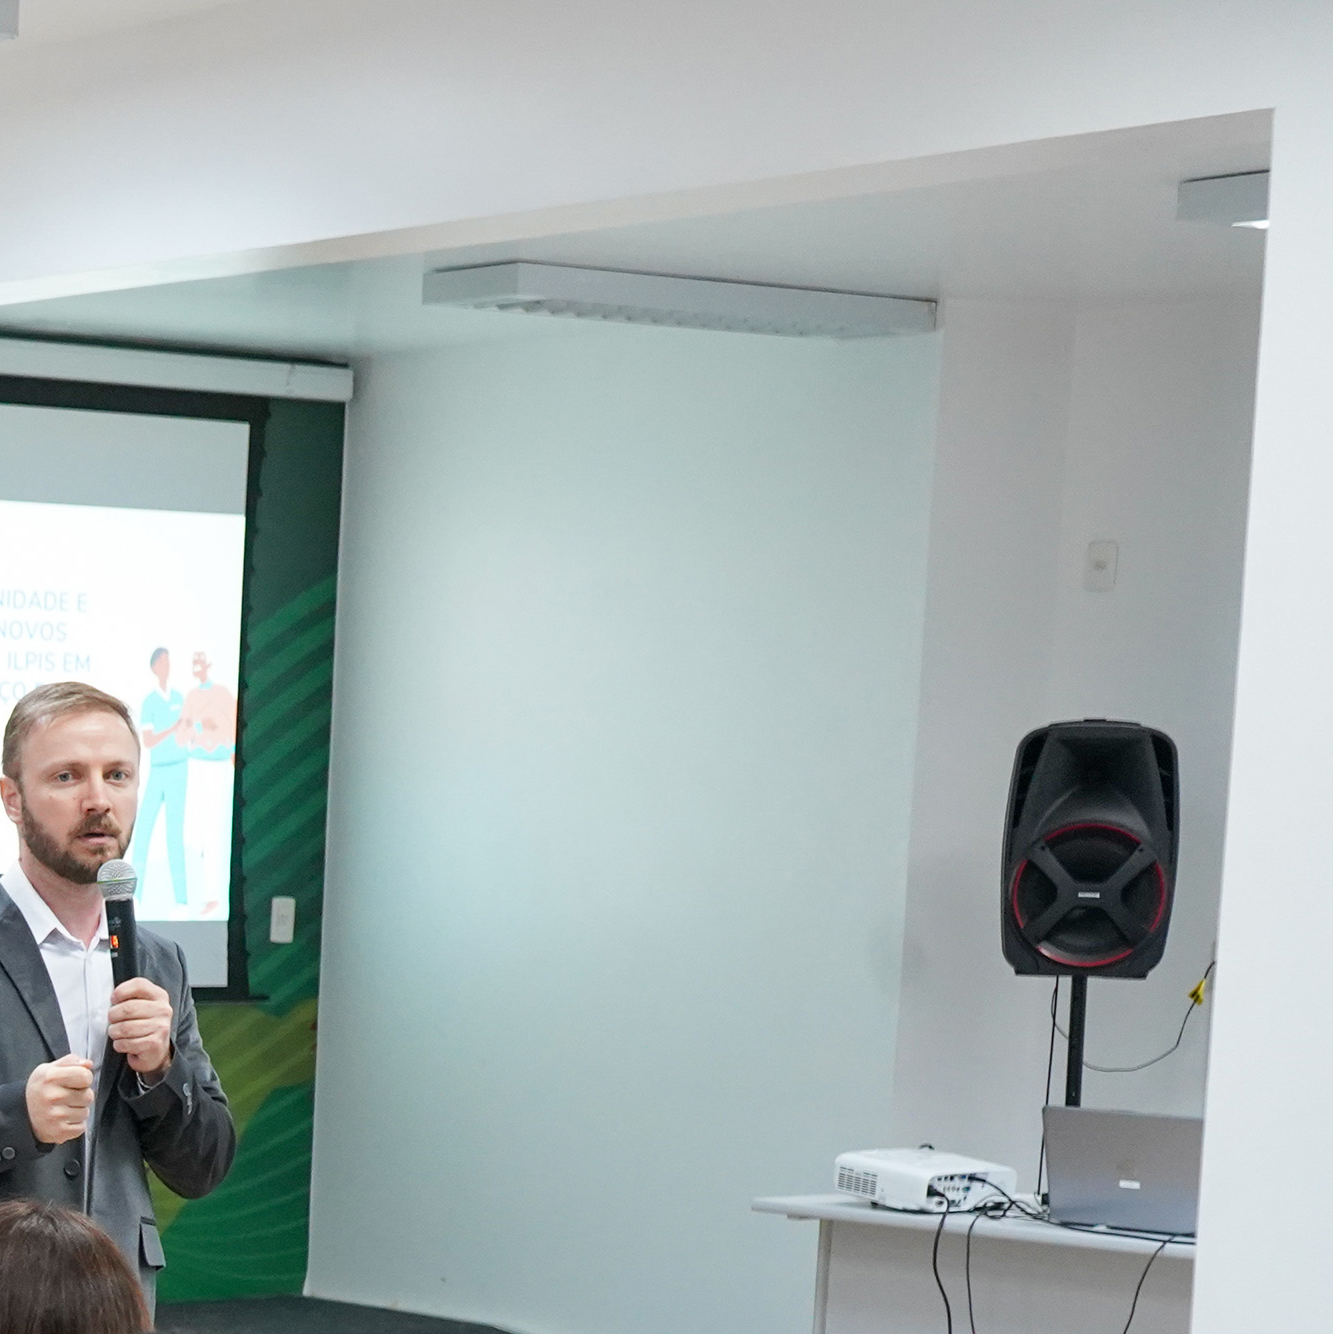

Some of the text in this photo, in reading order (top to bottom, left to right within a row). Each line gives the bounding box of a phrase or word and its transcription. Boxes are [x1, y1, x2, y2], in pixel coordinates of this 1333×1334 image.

[77, 592, 88, 613] E
[7, 651, 56, 673] ILPIS
[63, 652, 91, 674] EM
